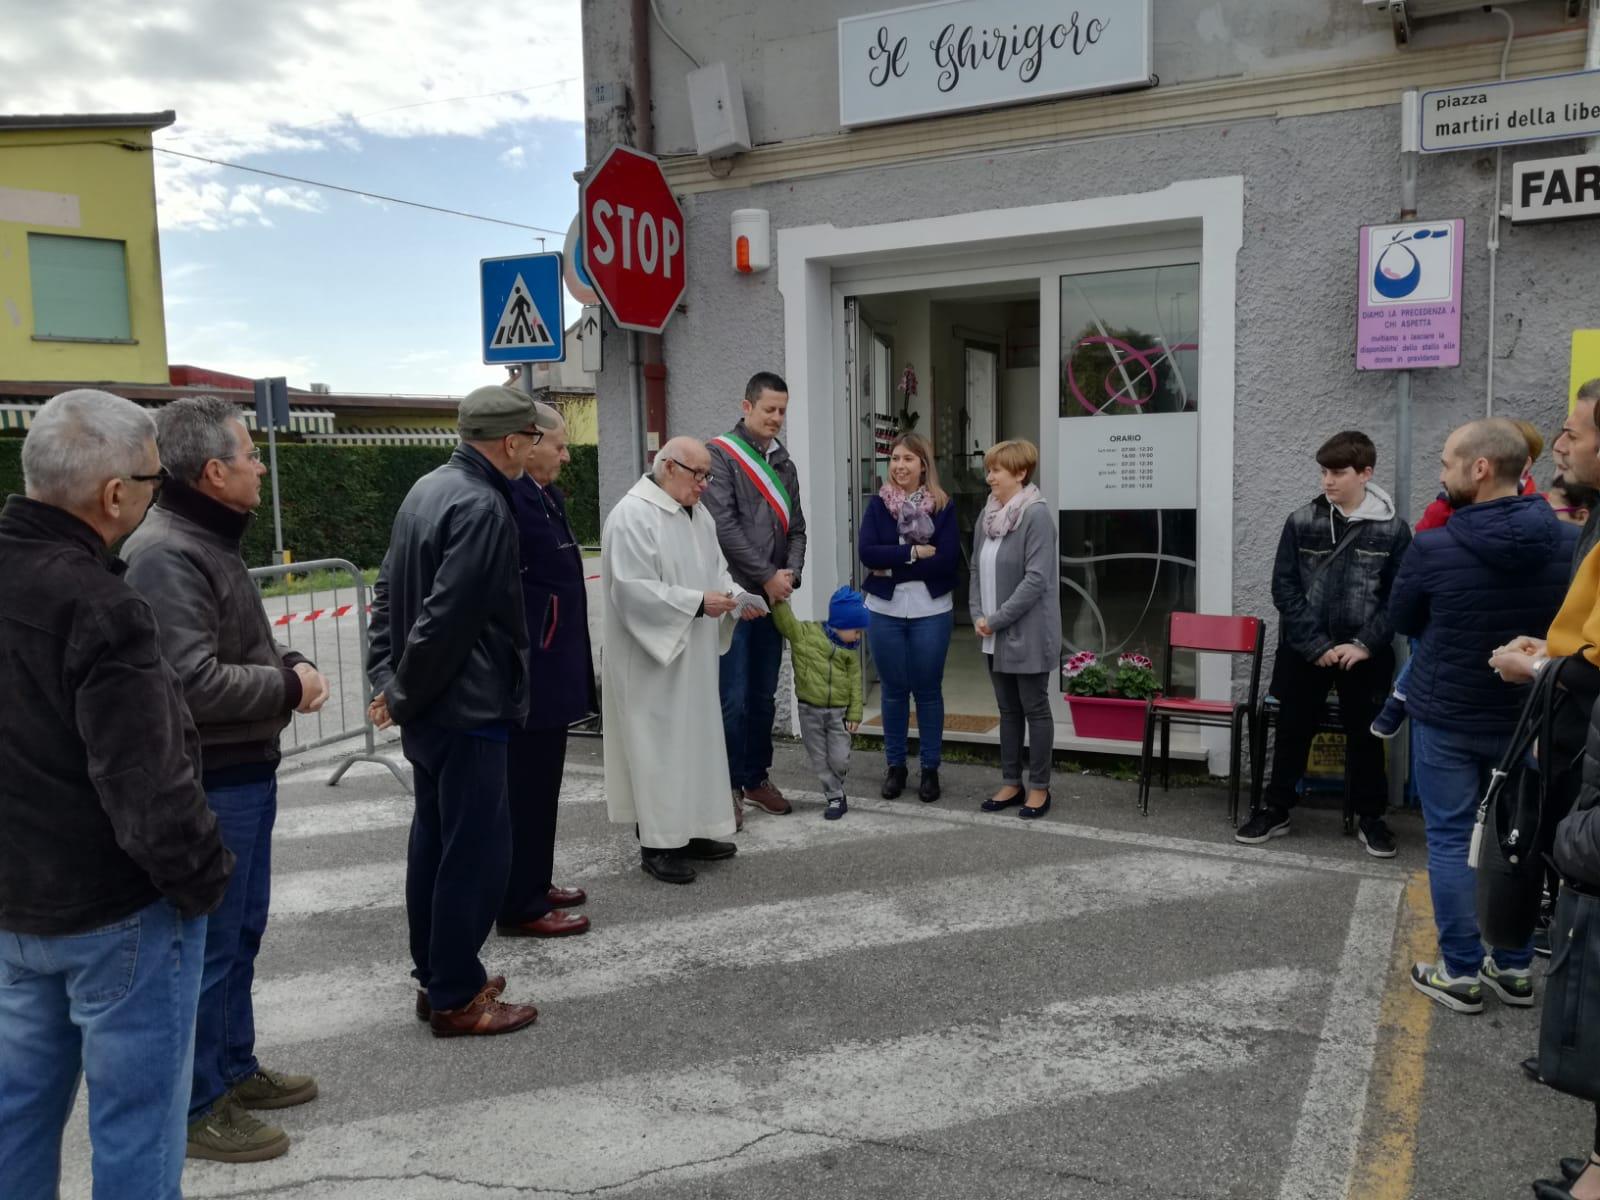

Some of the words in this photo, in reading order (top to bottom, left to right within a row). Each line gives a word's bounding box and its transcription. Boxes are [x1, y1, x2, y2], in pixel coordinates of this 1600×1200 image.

[929, 11, 1110, 92] Ghirigoro
[1436, 93, 1487, 111] piazza
[1436, 112, 1500, 137] martiri
[1507, 107, 1556, 129] della
[1564, 102, 1600, 122] libe
[592, 199, 680, 279] STOP
[1362, 311, 1384, 319] DIAMO
[1401, 307, 1446, 317] PRECEDENZA
[1450, 306, 1455, 314] A
[1401, 319, 1431, 327] ASPETTA
[1109, 434, 1141, 442] ORARIO
